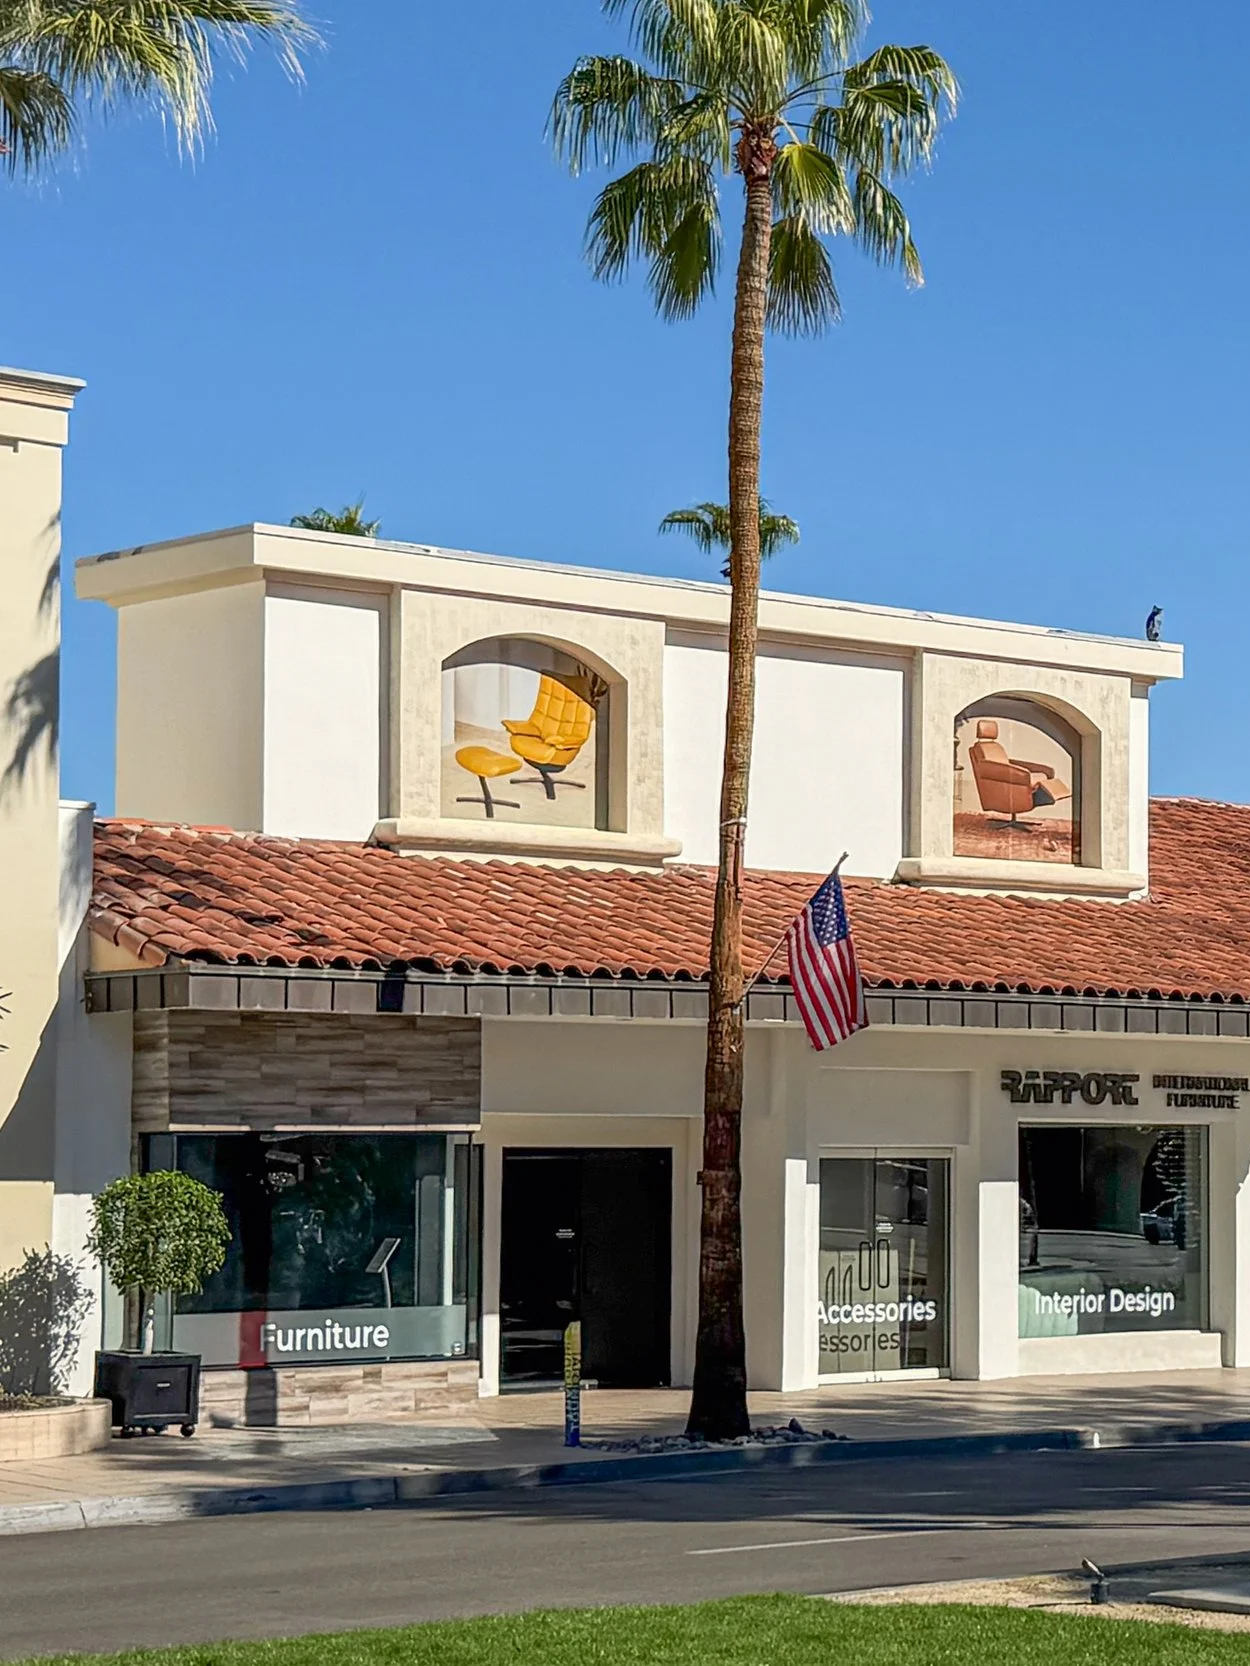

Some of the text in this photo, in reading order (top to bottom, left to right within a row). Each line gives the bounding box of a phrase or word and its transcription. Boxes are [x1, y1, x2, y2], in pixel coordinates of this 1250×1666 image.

[1001, 1070, 1140, 1105] RAPPORT
[817, 1294, 937, 1325] Accessories
[1034, 1285, 1175, 1318] Interior Design
[260, 1318, 390, 1352] Furniture
